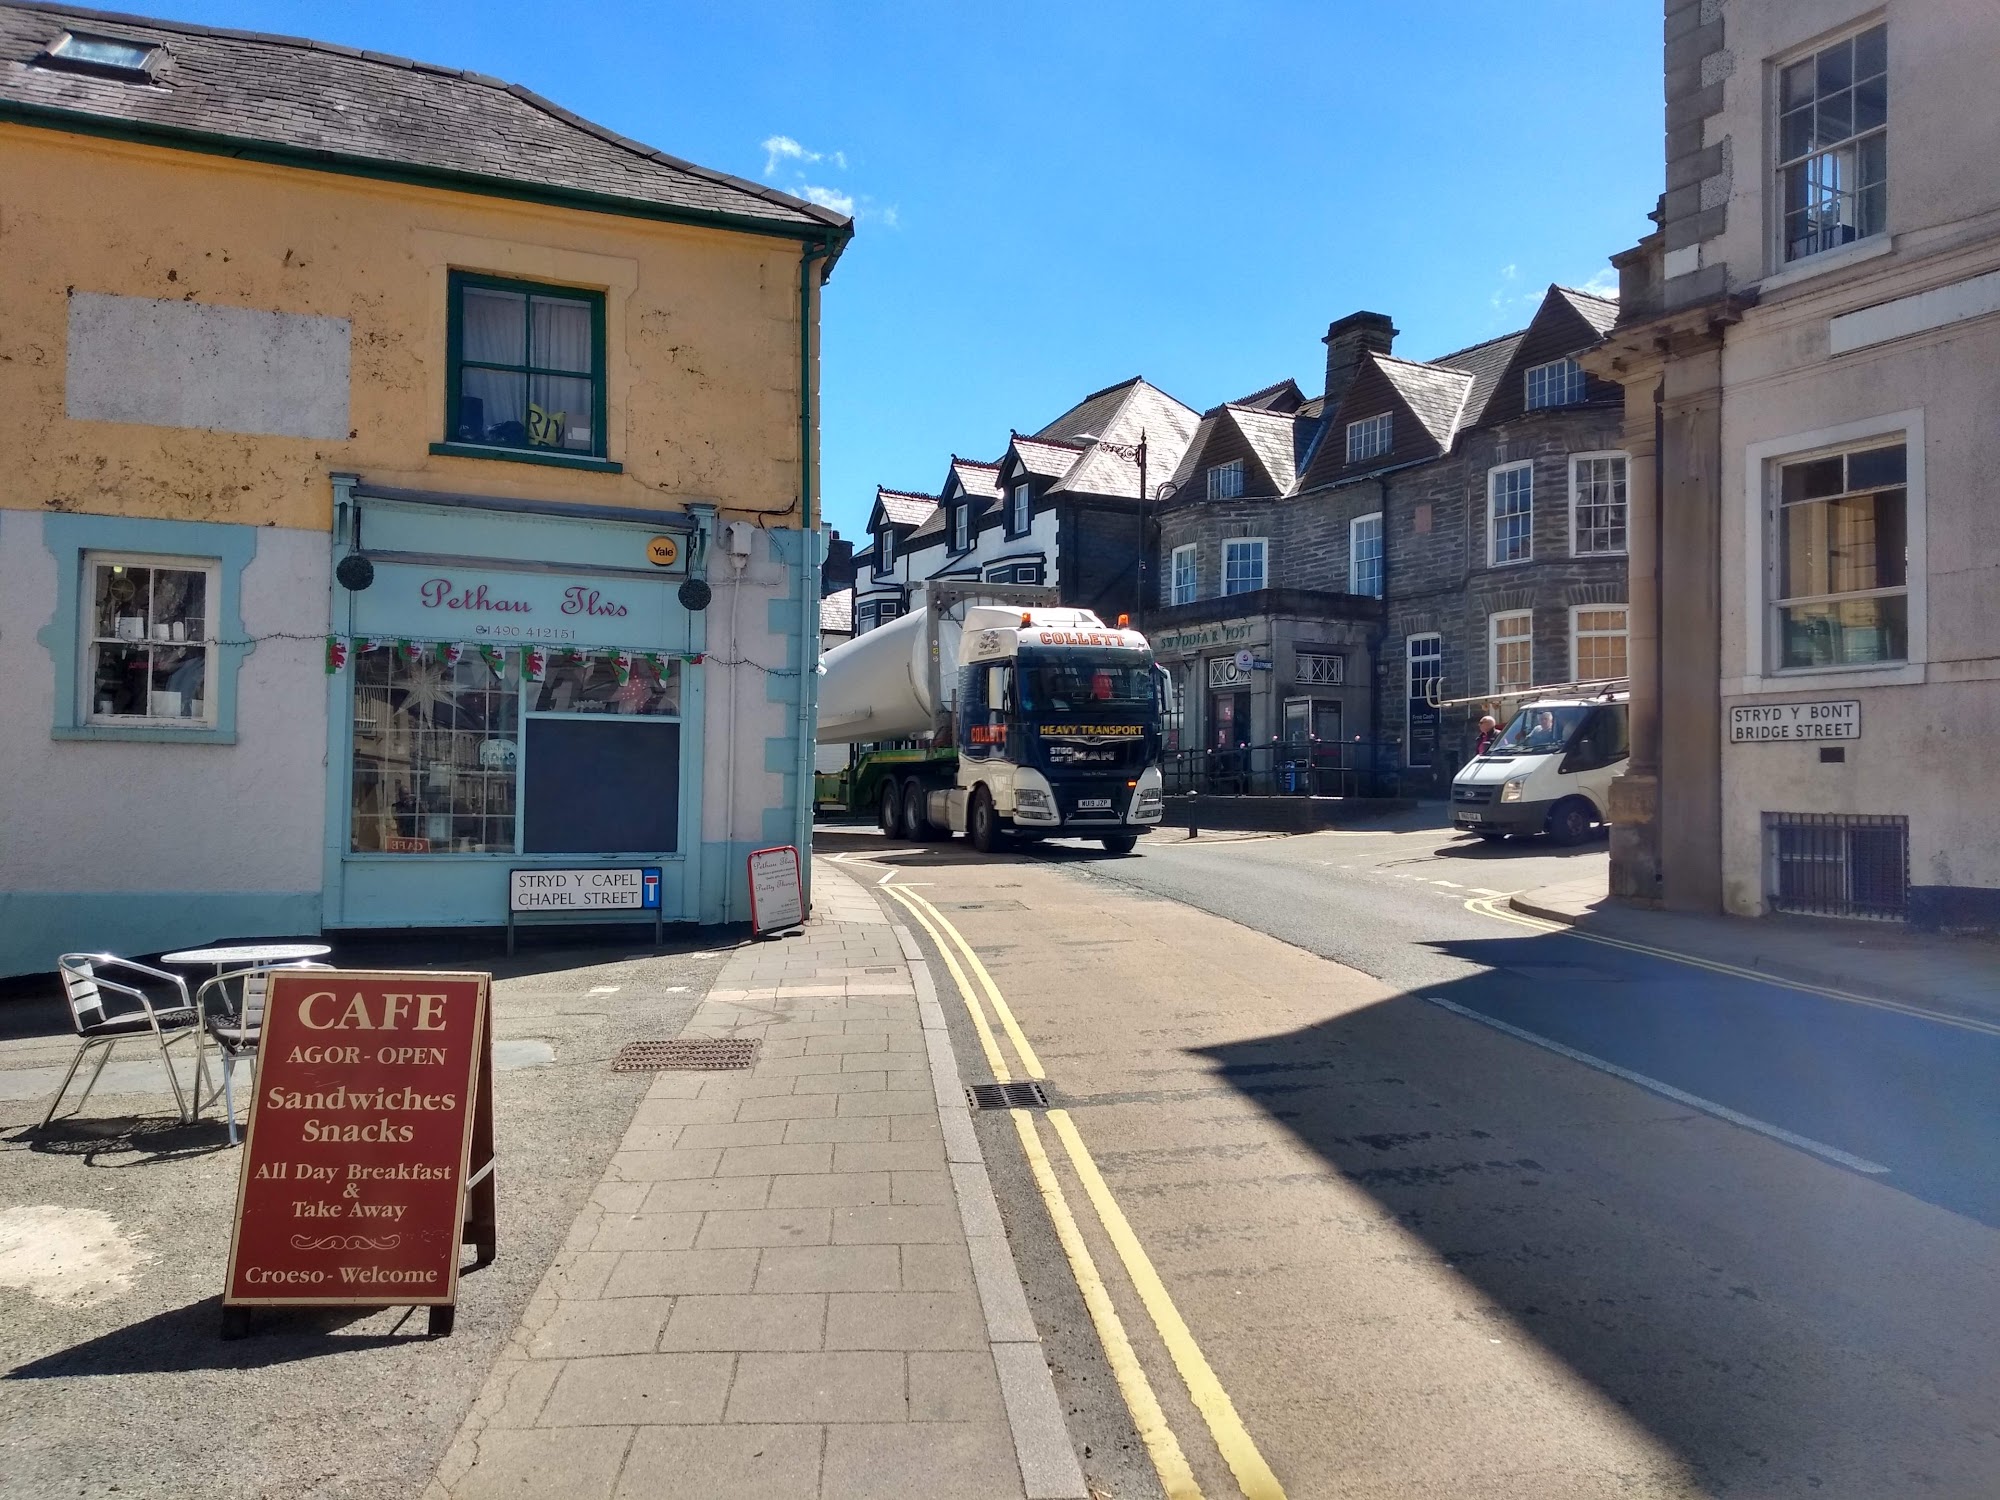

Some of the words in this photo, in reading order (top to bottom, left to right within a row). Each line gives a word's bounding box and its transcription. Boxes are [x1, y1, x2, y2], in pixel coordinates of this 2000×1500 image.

[653, 546, 674, 557] Yale
[420, 578, 533, 613] Pethau
[560, 586, 628, 617] Tlws
[526, 627, 576, 640] 412151
[1040, 631, 1125, 647] COLLETT
[1226, 624, 1254, 641] POST
[1735, 708, 1782, 722] STRYD
[1791, 707, 1800, 720] Y
[1810, 704, 1853, 719] BONT
[971, 725, 1007, 742] COLLETT
[1039, 725, 1077, 735] HEAVY
[1080, 725, 1144, 735] TRANSPORT
[1736, 725, 1789, 739] BRIDGE
[1795, 723, 1853, 738] STREET
[1049, 747, 1073, 755] STGO
[1073, 751, 1115, 761] MAN
[518, 874, 567, 888] STRYD
[574, 874, 585, 887] Y
[592, 873, 638, 887] CAPEL
[518, 892, 576, 906] CHAPEL
[583, 891, 638, 905] STREET
[298, 991, 448, 1031] CAFE
[377, 1046, 448, 1065] OPEN
[267, 1085, 456, 1111] Sandwiches
[302, 1118, 414, 1143] Snacks
[254, 1162, 287, 1180] All
[294, 1163, 340, 1184] Day
[346, 1162, 452, 1180] Breakfast
[342, 1182, 361, 1199] &
[292, 1200, 343, 1218] Take
[347, 1200, 408, 1222] Away
[338, 1265, 439, 1284] Welcome
